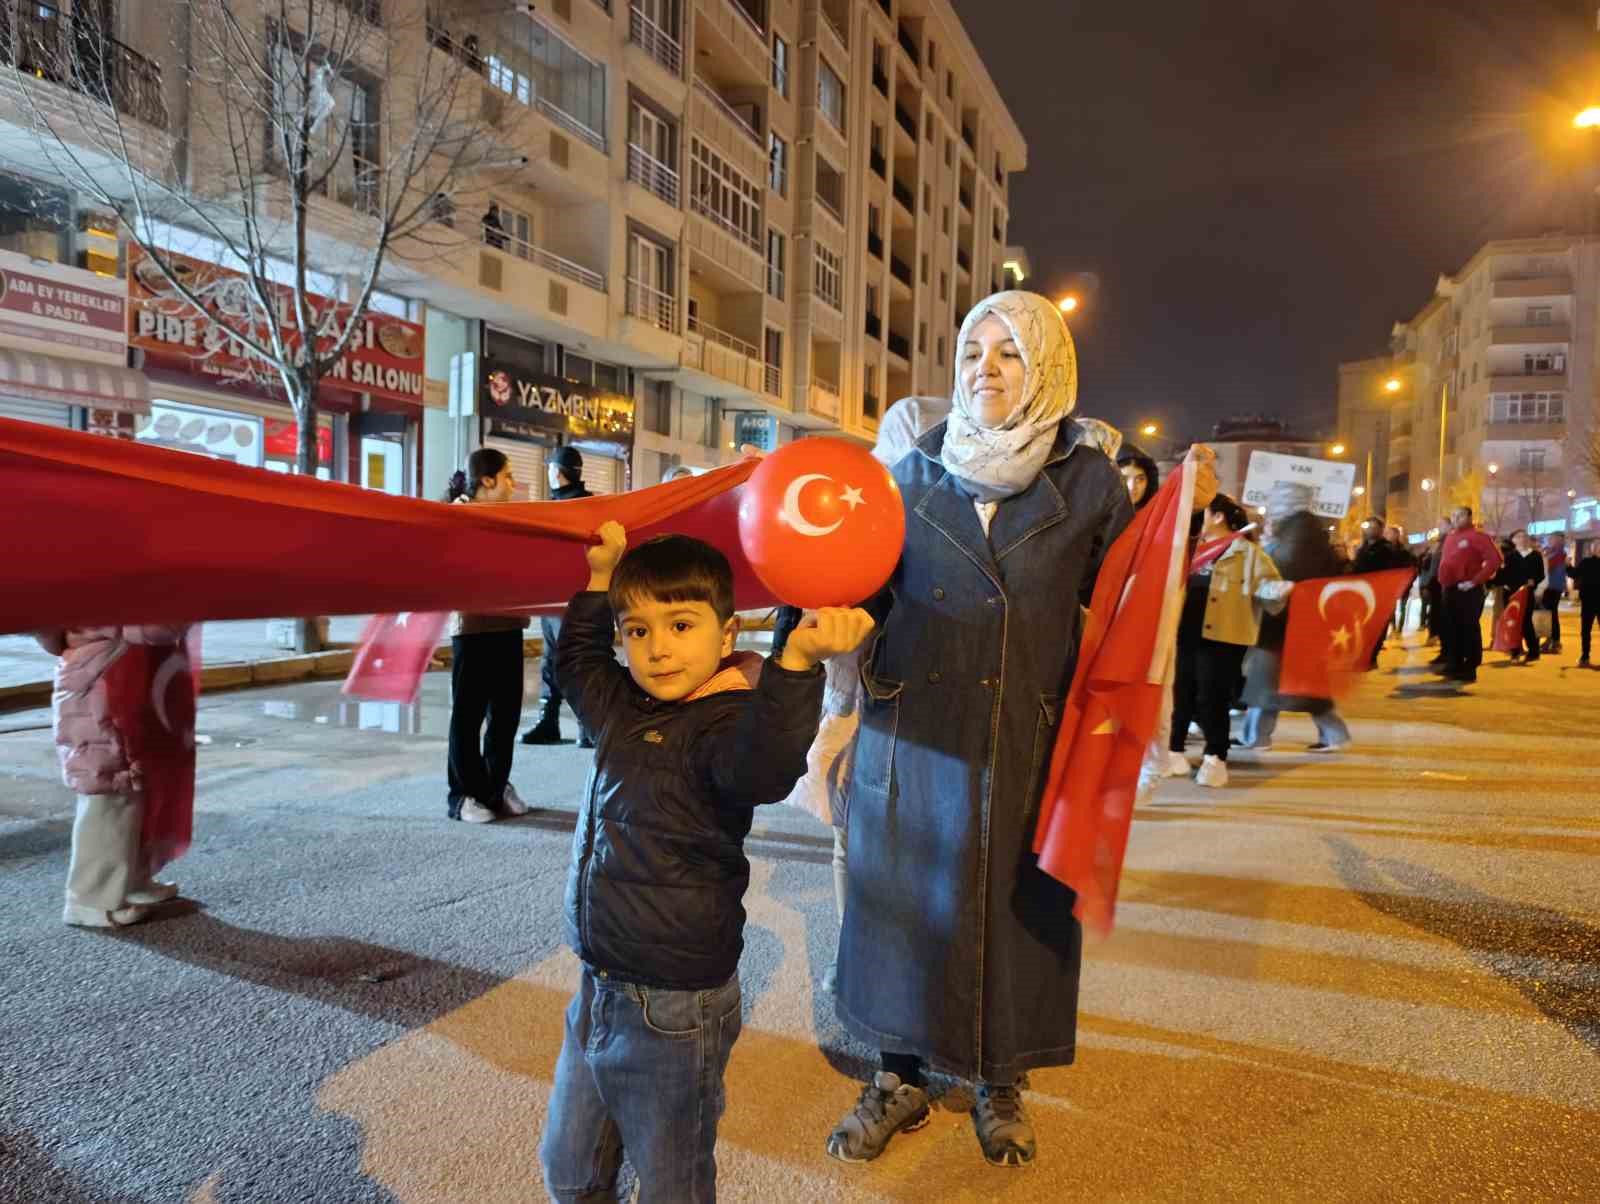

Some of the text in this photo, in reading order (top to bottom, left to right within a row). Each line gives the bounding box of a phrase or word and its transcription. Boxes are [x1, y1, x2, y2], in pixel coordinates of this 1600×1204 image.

[9, 278, 34, 294] ADA
[38, 284, 54, 299] EV
[32, 301, 89, 323] & PASTA
[351, 360, 422, 395] SALONU
[1290, 464, 1313, 473] VAN
